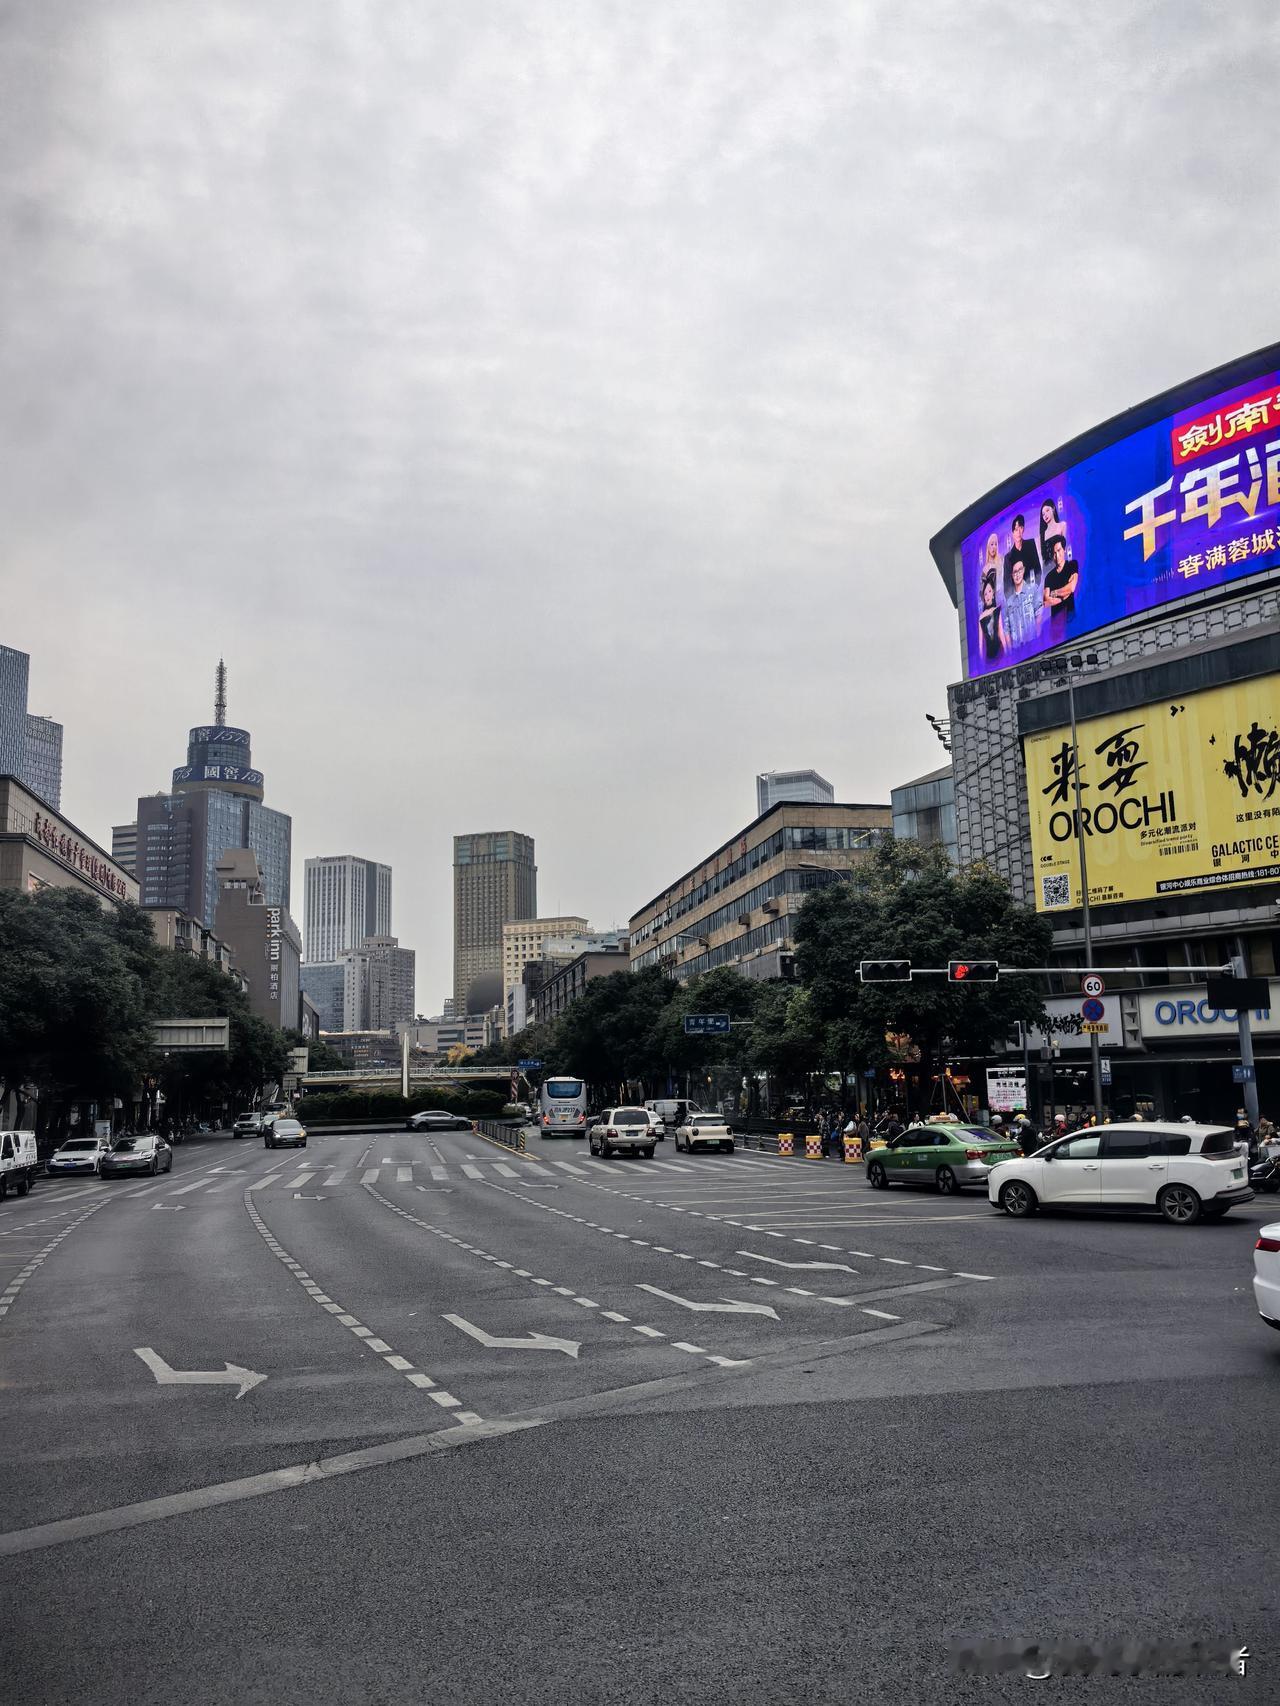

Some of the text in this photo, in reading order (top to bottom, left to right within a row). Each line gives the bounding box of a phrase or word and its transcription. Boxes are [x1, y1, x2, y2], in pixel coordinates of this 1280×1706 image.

[1178, 526, 1280, 579] 春满蓉城
[1049, 790, 1176, 842] OROCHI
[1140, 822, 1197, 840] 多元化潮流派对
[1211, 837, 1263, 858] GALACTIC
[1076, 885, 1114, 897] 扫二维码了解
[266, 908, 283, 960] park inn
[1086, 981, 1101, 991] 60
